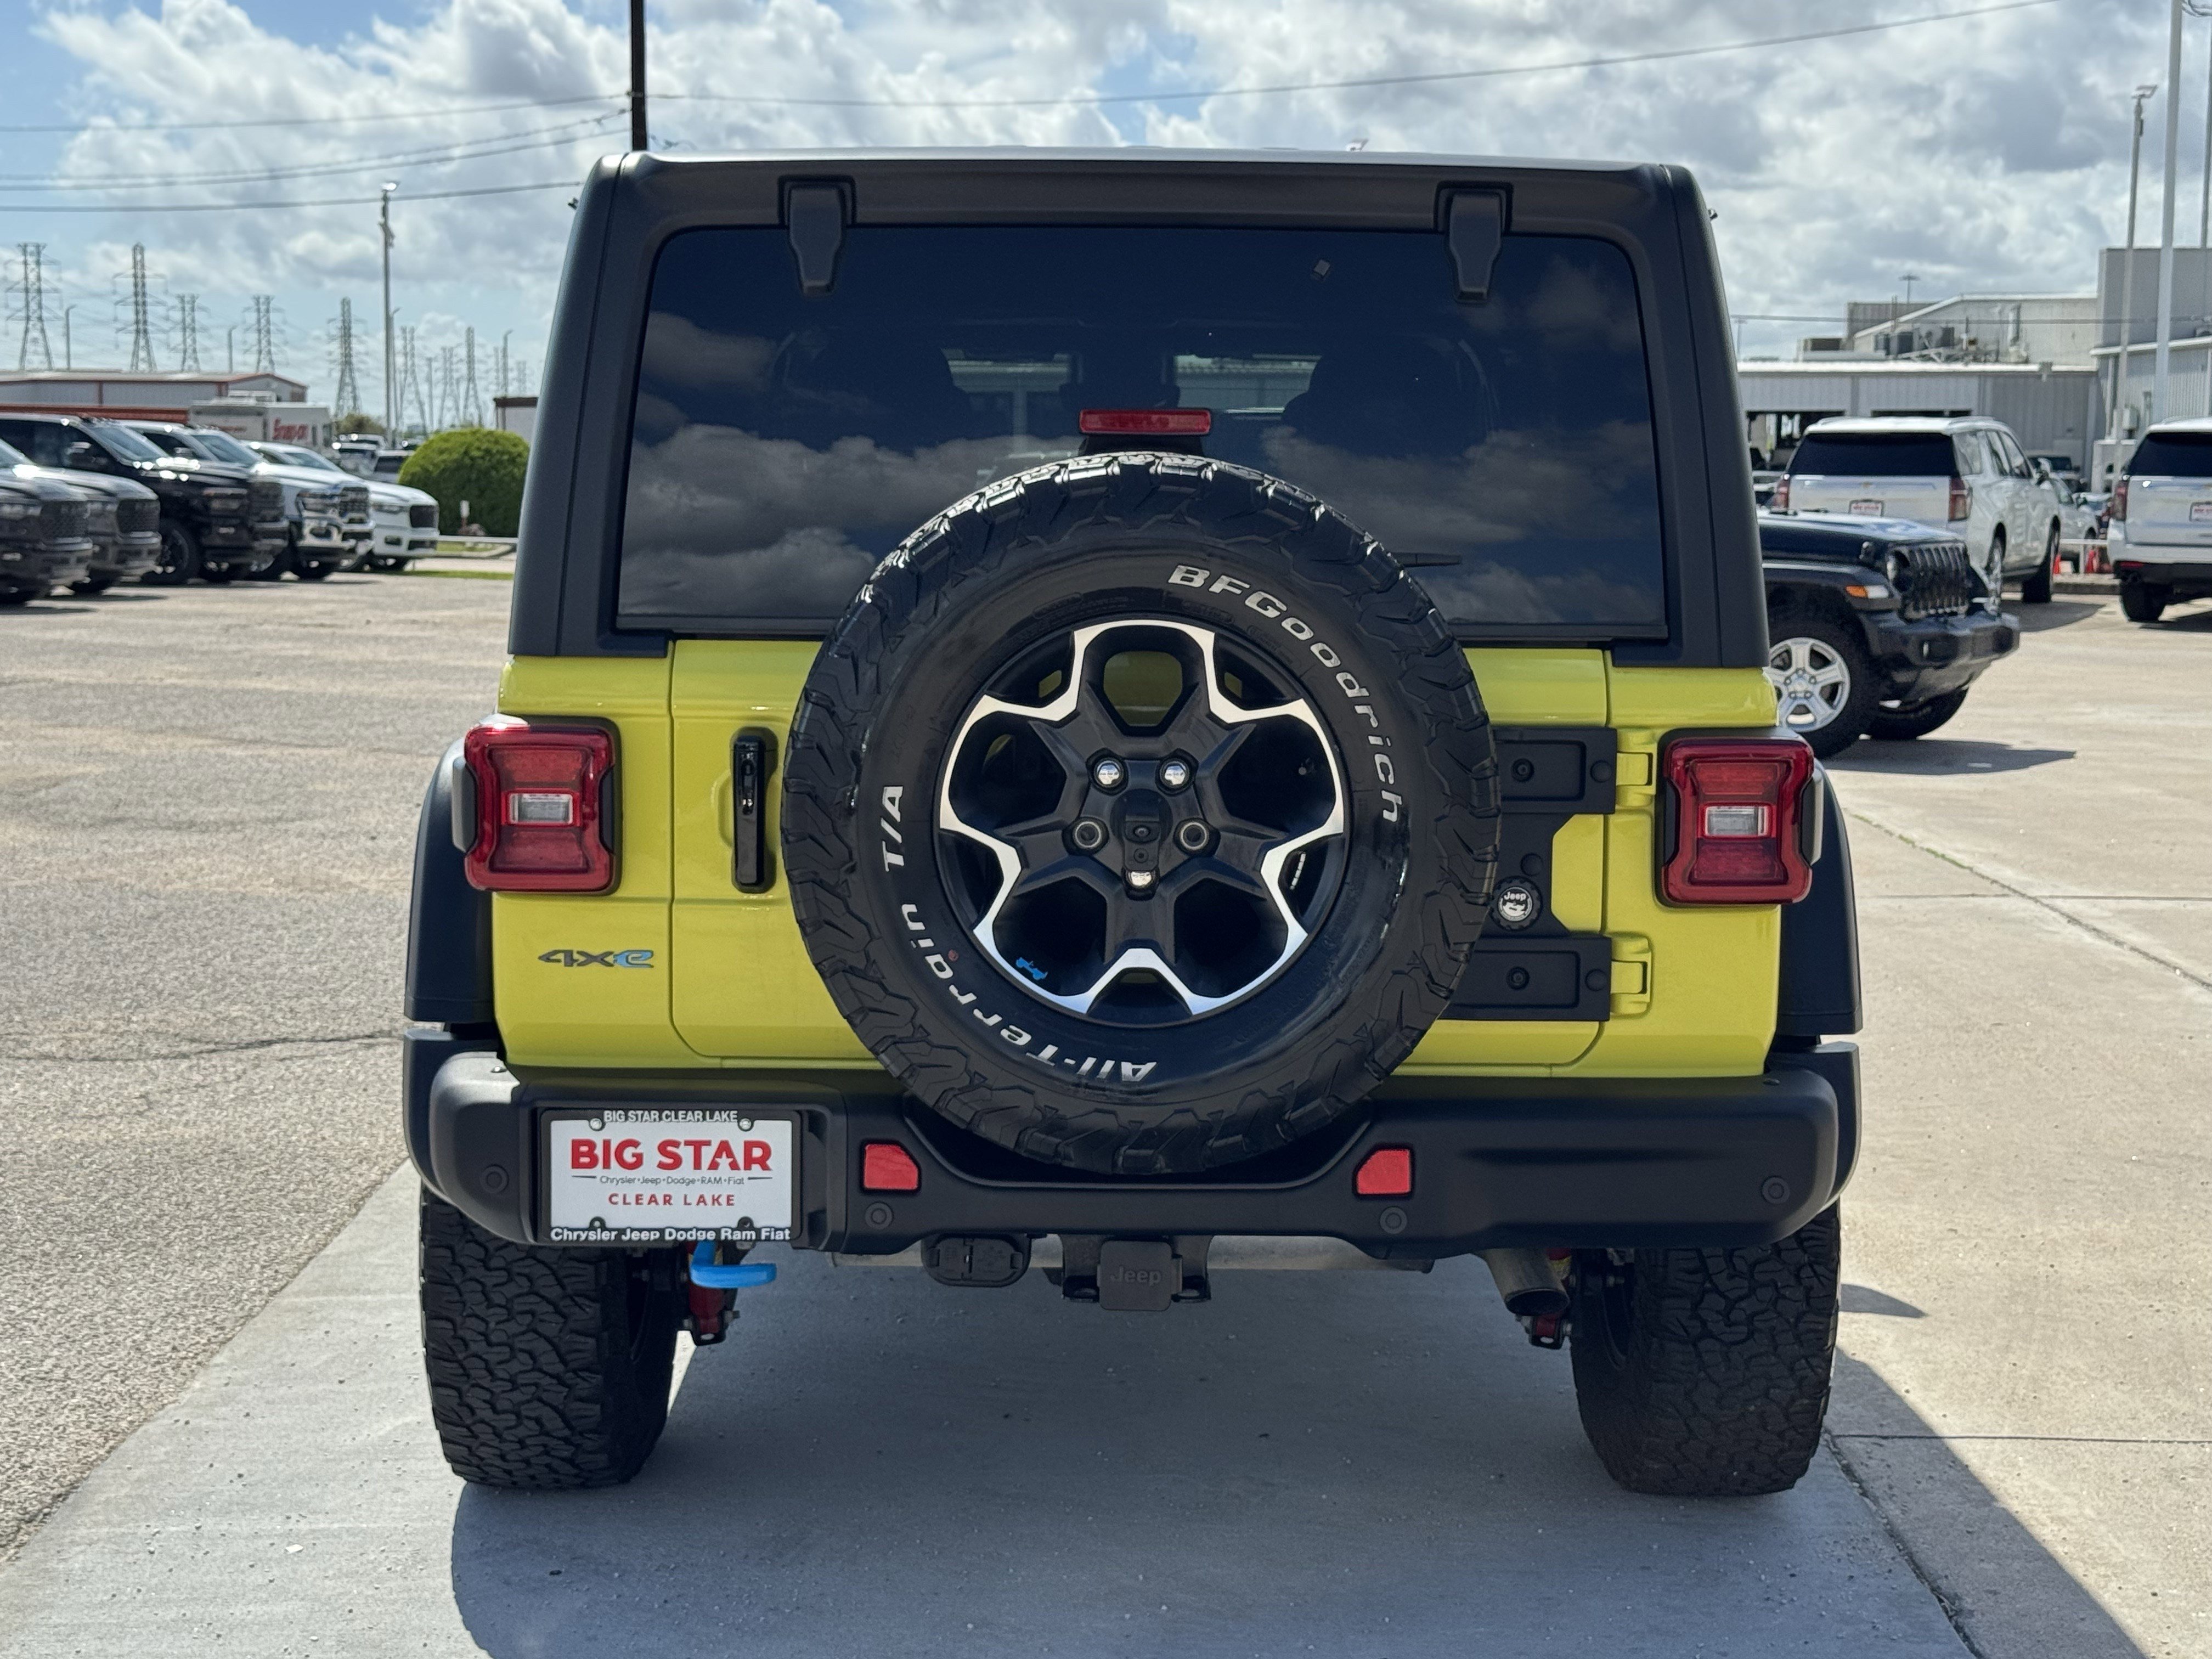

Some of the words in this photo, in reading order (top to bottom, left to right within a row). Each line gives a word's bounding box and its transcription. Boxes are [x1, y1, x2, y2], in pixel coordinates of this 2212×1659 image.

[1168, 565, 1402, 822] BFGoodrich
[881, 786, 905, 872] T/A
[1504, 891, 1526, 901] Jeep
[901, 904, 1157, 1082] All-Terrain
[604, 1110, 625, 1122] BIG
[628, 1110, 659, 1123] STAR
[662, 1110, 703, 1123] CLEAR
[706, 1110, 737, 1123] LAKE
[571, 1138, 644, 1170] BIG
[656, 1139, 772, 1171] STAR
[608, 1193, 673, 1206] CLEAR
[683, 1194, 735, 1206] LAKE
[550, 1228, 618, 1242] Chrysler
[621, 1228, 661, 1242] Jeep
[664, 1228, 716, 1241] Dodge
[720, 1228, 756, 1240] Ram
[761, 1228, 791, 1240] Fiat
[1110, 1265, 1162, 1287] Jeep
